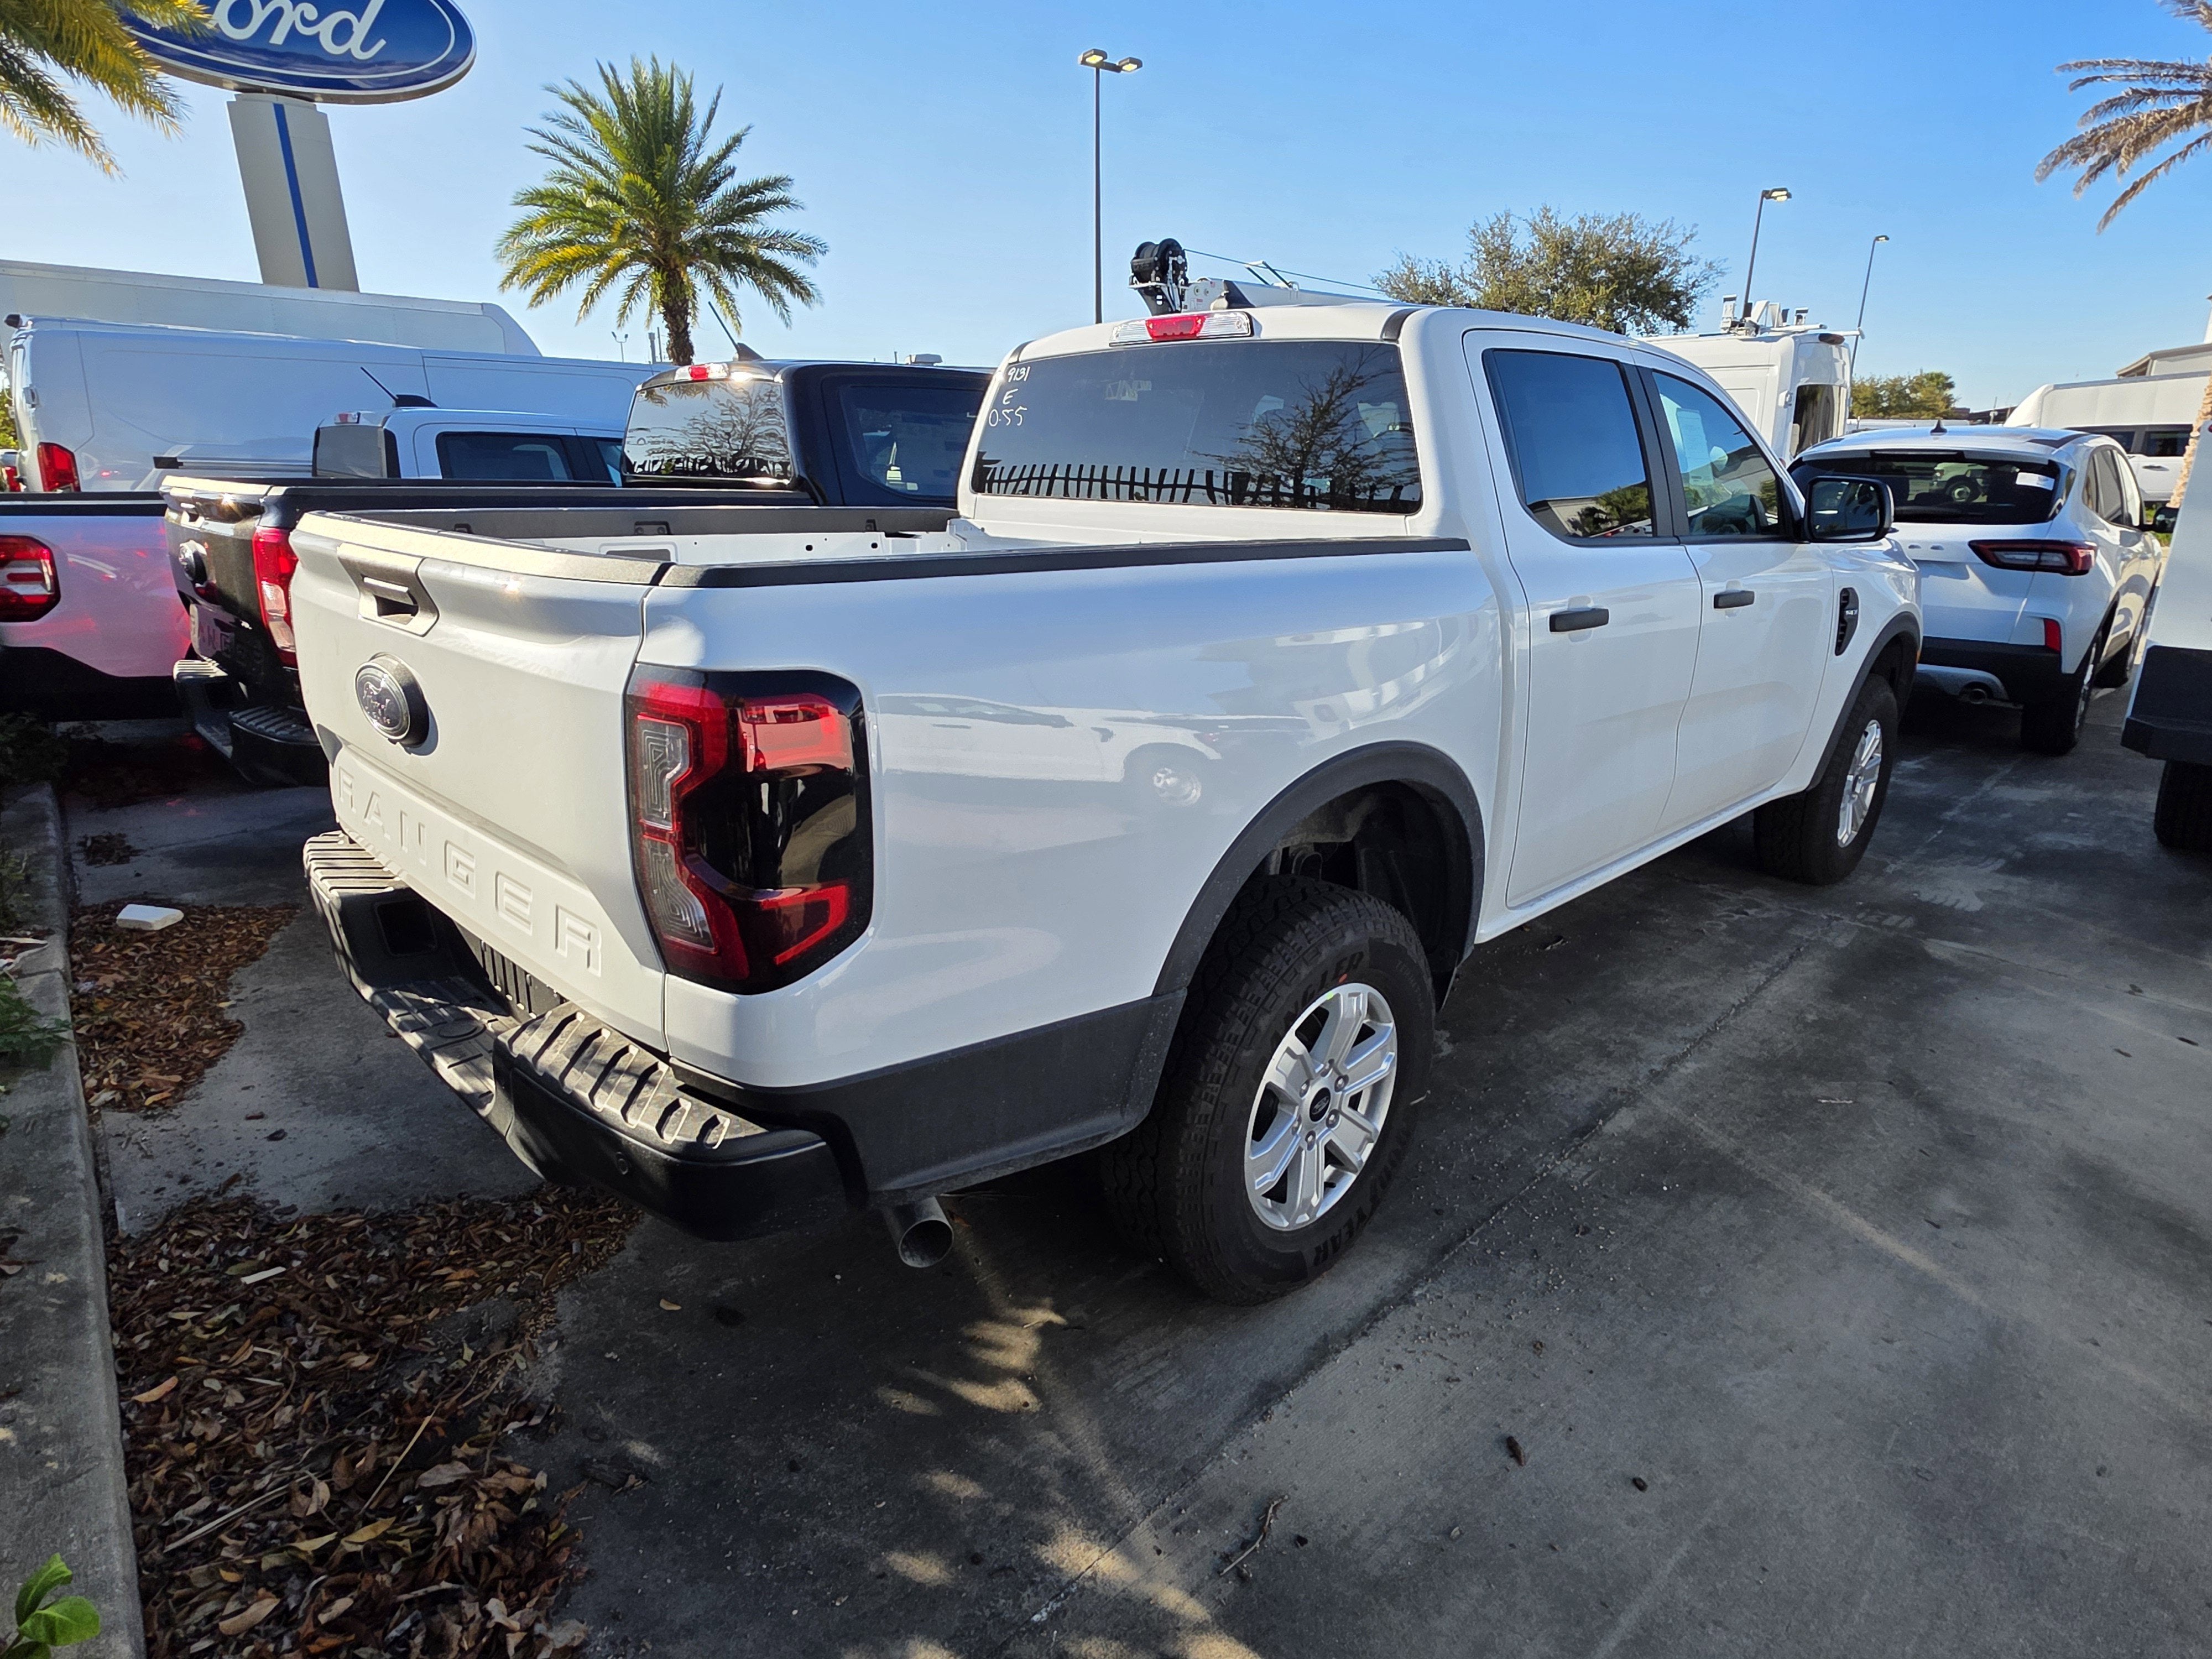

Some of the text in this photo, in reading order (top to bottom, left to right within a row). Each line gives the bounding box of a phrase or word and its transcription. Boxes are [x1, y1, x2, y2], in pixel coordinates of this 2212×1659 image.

[166, 0, 386, 60] ord
[1008, 366, 1031, 383] 9131
[1002, 388, 1019, 405] E
[338, 766, 602, 978] RANGER
